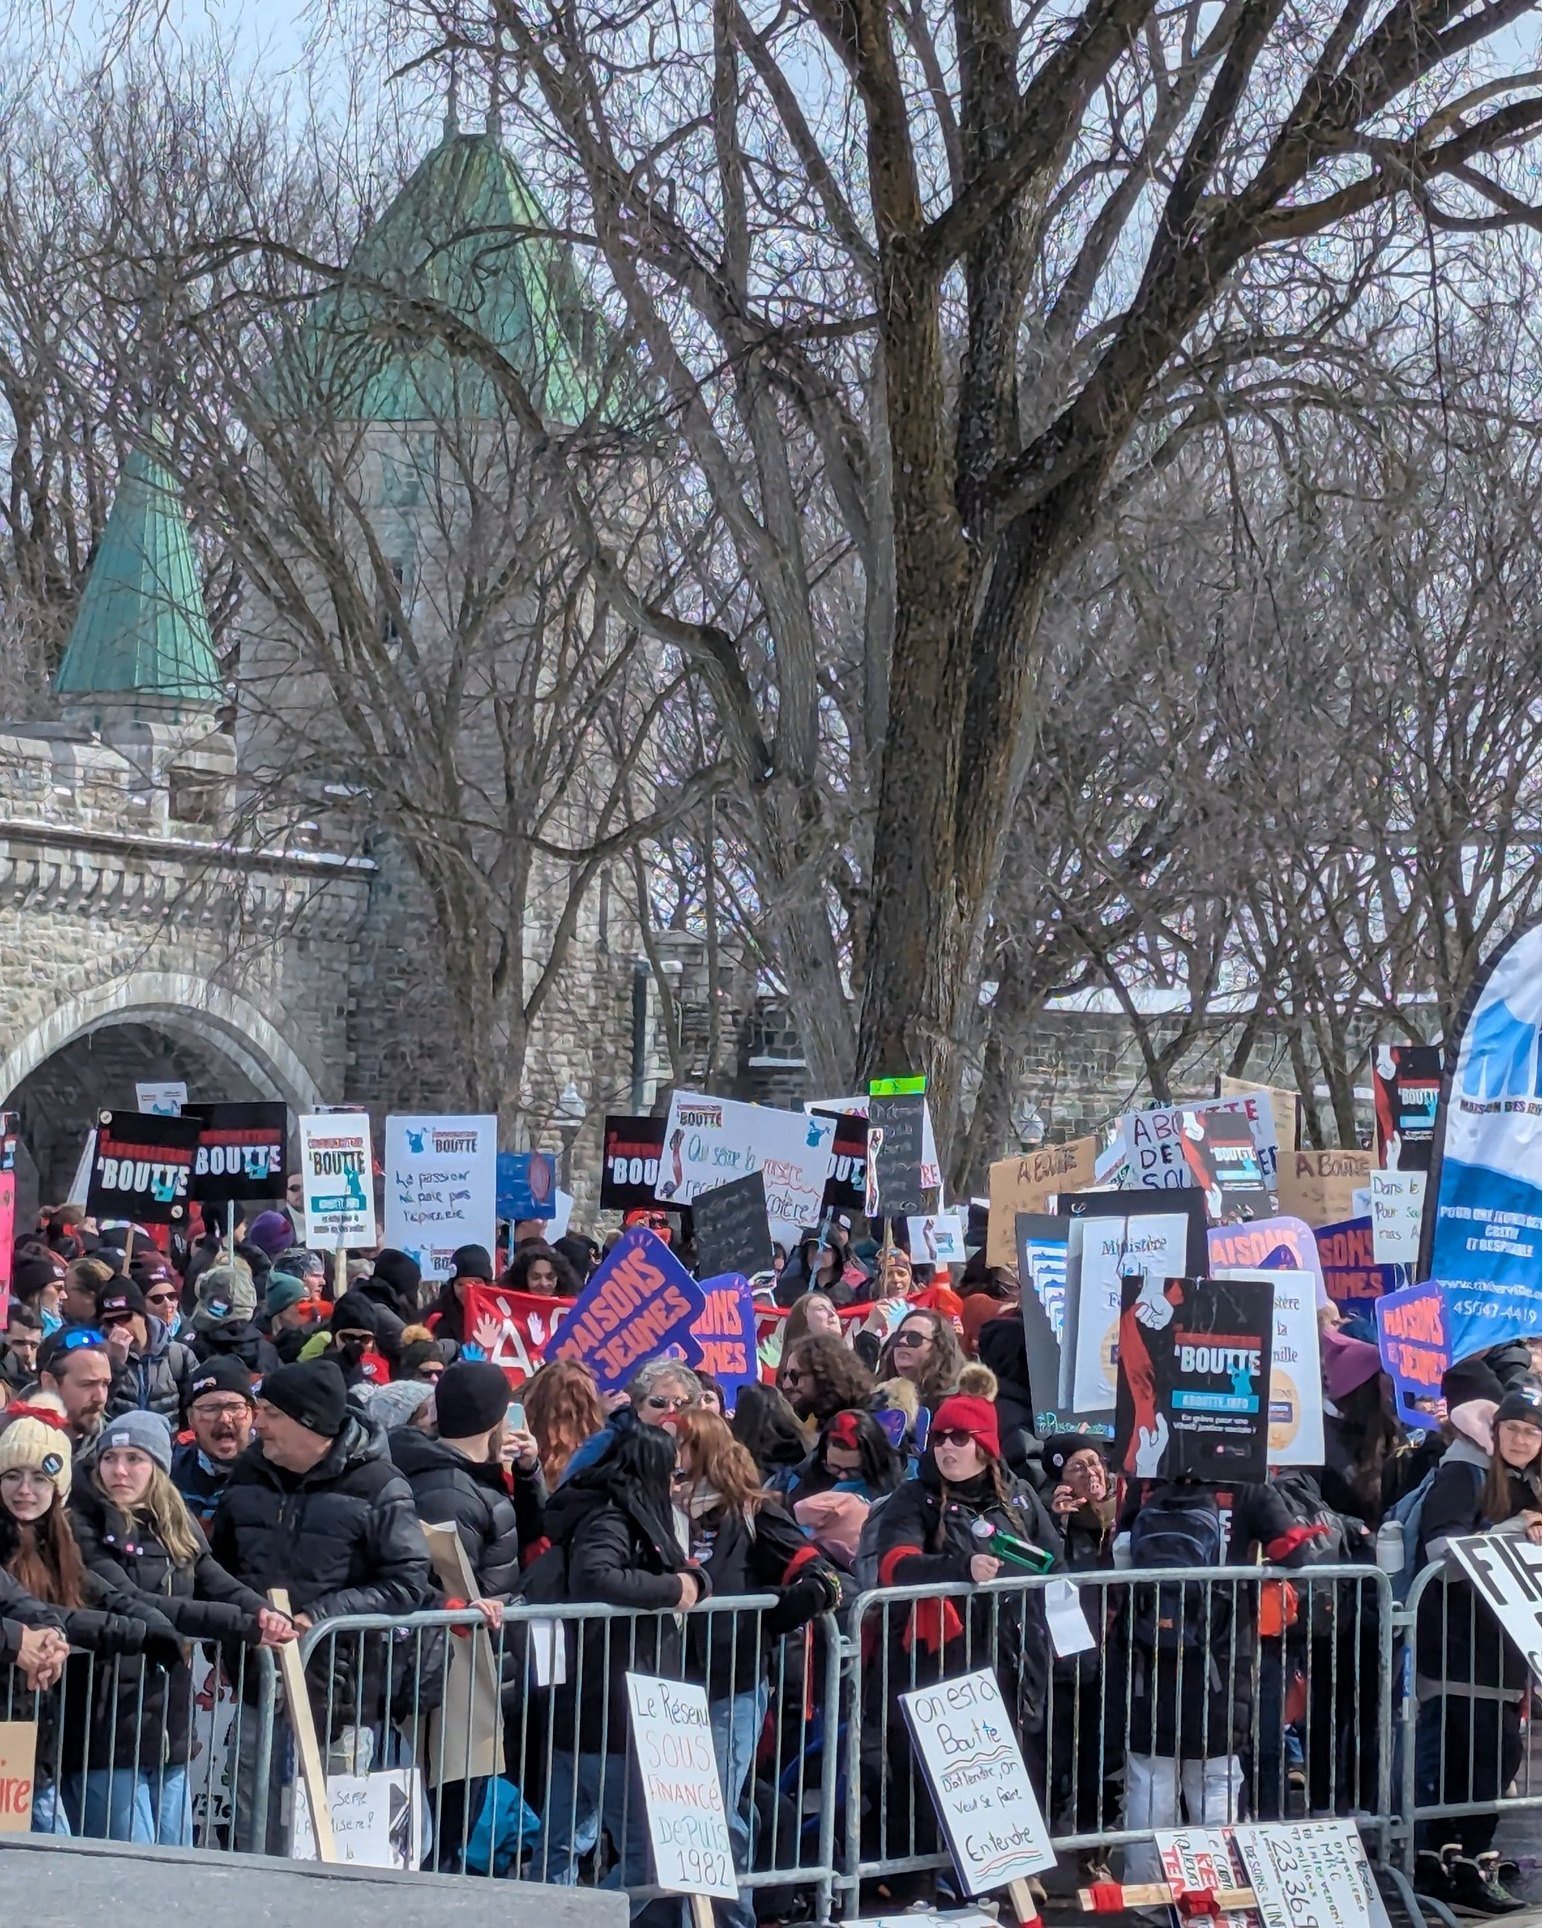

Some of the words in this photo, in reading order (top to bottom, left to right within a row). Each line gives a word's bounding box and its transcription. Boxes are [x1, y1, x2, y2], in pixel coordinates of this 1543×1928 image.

[194, 1146, 282, 1176] BOUTTE
[435, 1138, 478, 1153] BOUTTE
[101, 1158, 191, 1196] BOUTTE
[594, 1285, 691, 1380] JEUNES
[1180, 1346, 1262, 1377] BOUTTE
[645, 1730, 712, 1773] SOUS
[676, 1848, 731, 1888] 1982
